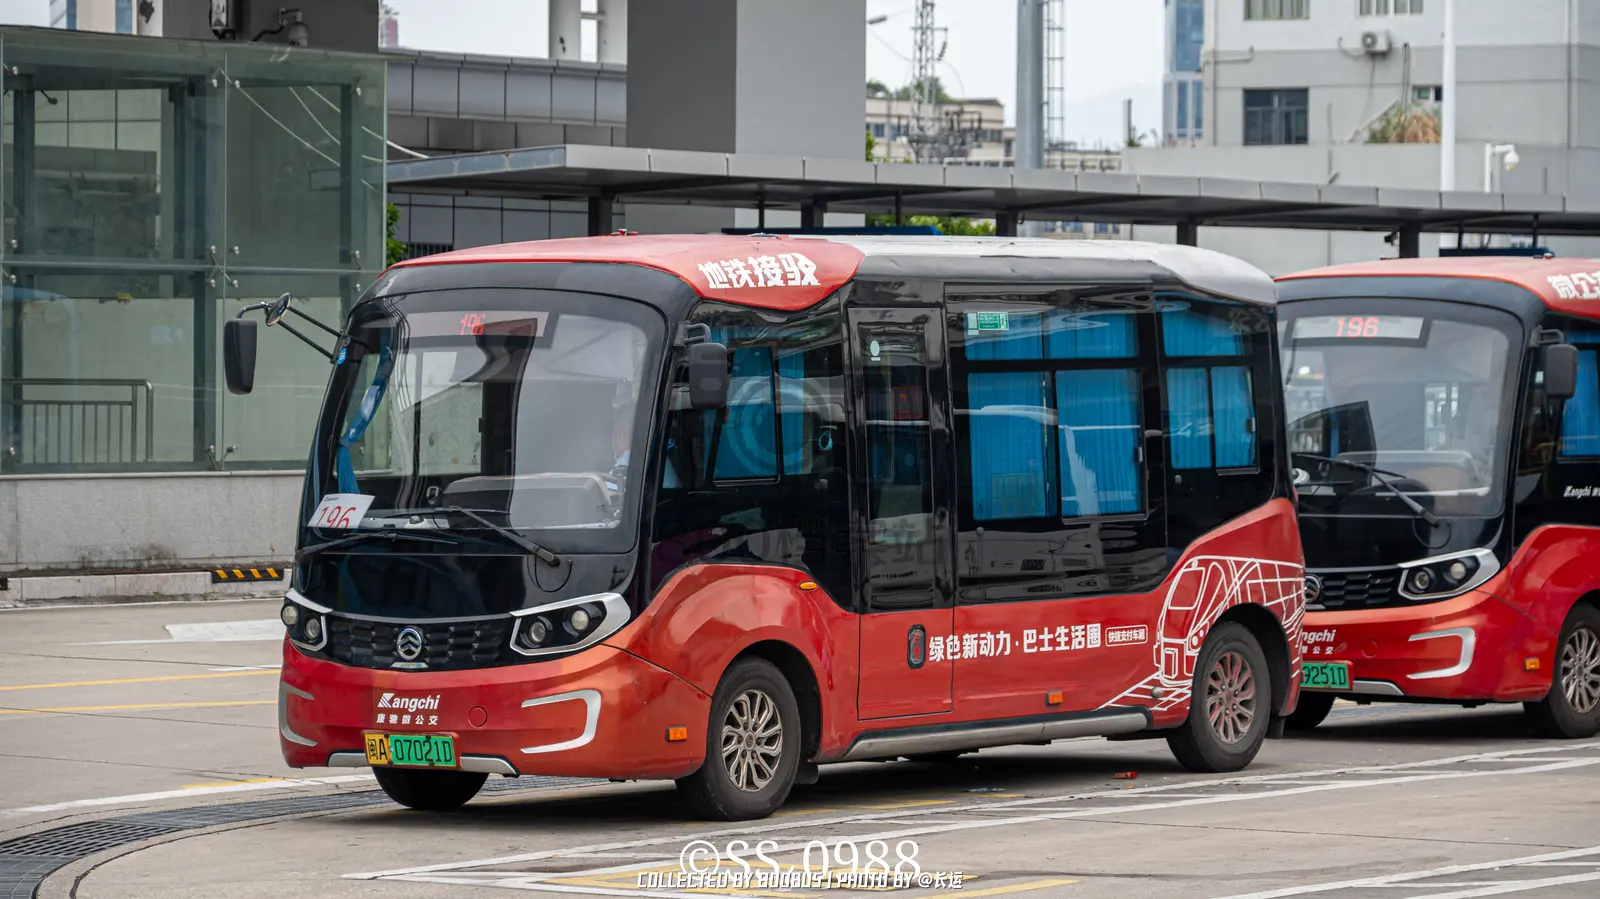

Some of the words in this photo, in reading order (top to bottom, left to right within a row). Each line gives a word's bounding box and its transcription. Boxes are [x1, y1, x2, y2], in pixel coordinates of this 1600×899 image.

[698, 252, 820, 289] 地铁接驳
[1546, 270, 1600, 300] 微公
[460, 313, 487, 336] 196
[1336, 316, 1380, 338] 196
[315, 505, 356, 528] 196
[1301, 629, 1336, 644] ngchi
[377, 692, 441, 712] Kangchi
[376, 713, 439, 725] 康驰微公交
[394, 739, 453, 762] 07021D
